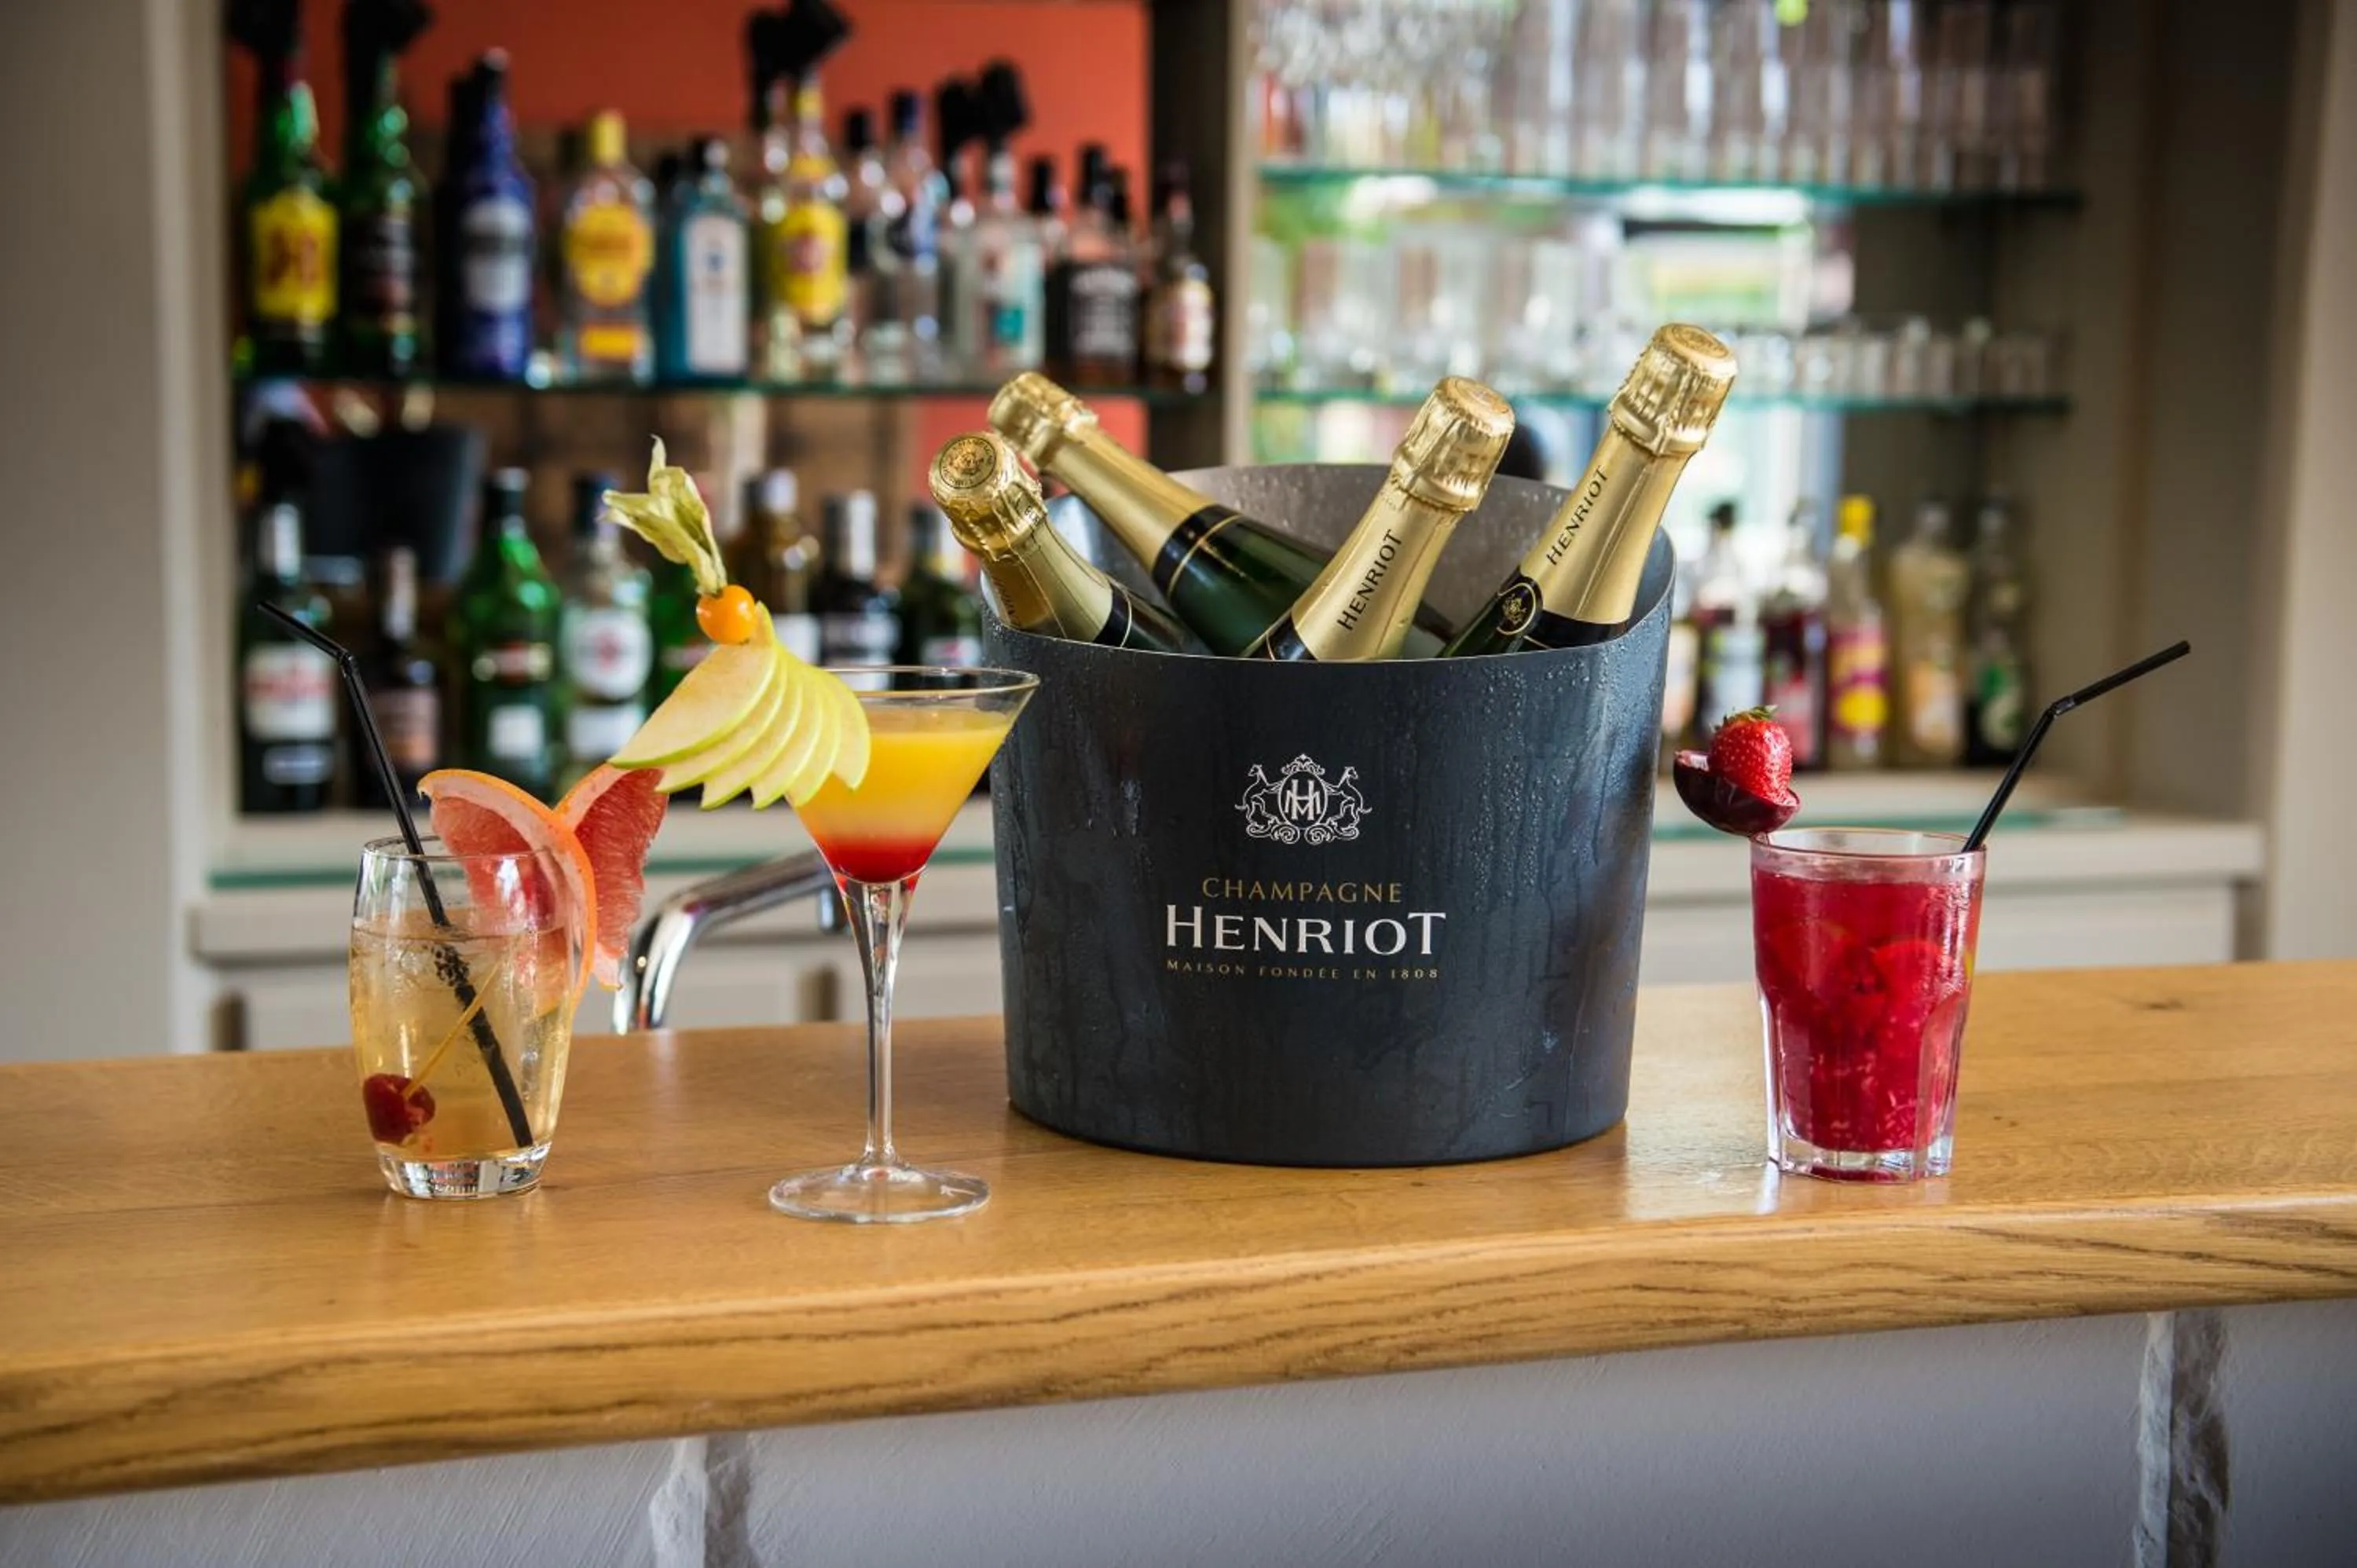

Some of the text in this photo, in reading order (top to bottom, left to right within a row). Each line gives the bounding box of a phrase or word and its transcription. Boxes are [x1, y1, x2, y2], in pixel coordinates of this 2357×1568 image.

[1545, 465, 1607, 566] HENRIOT
[1336, 528, 1402, 631] HENRIOT
[1201, 877, 1403, 903] CHAMPAGNE
[1166, 904, 1446, 956] HENRIOT
[1166, 958, 1245, 976] MAISON
[1353, 968, 1376, 980] EN
[1390, 968, 1439, 980] 1808
